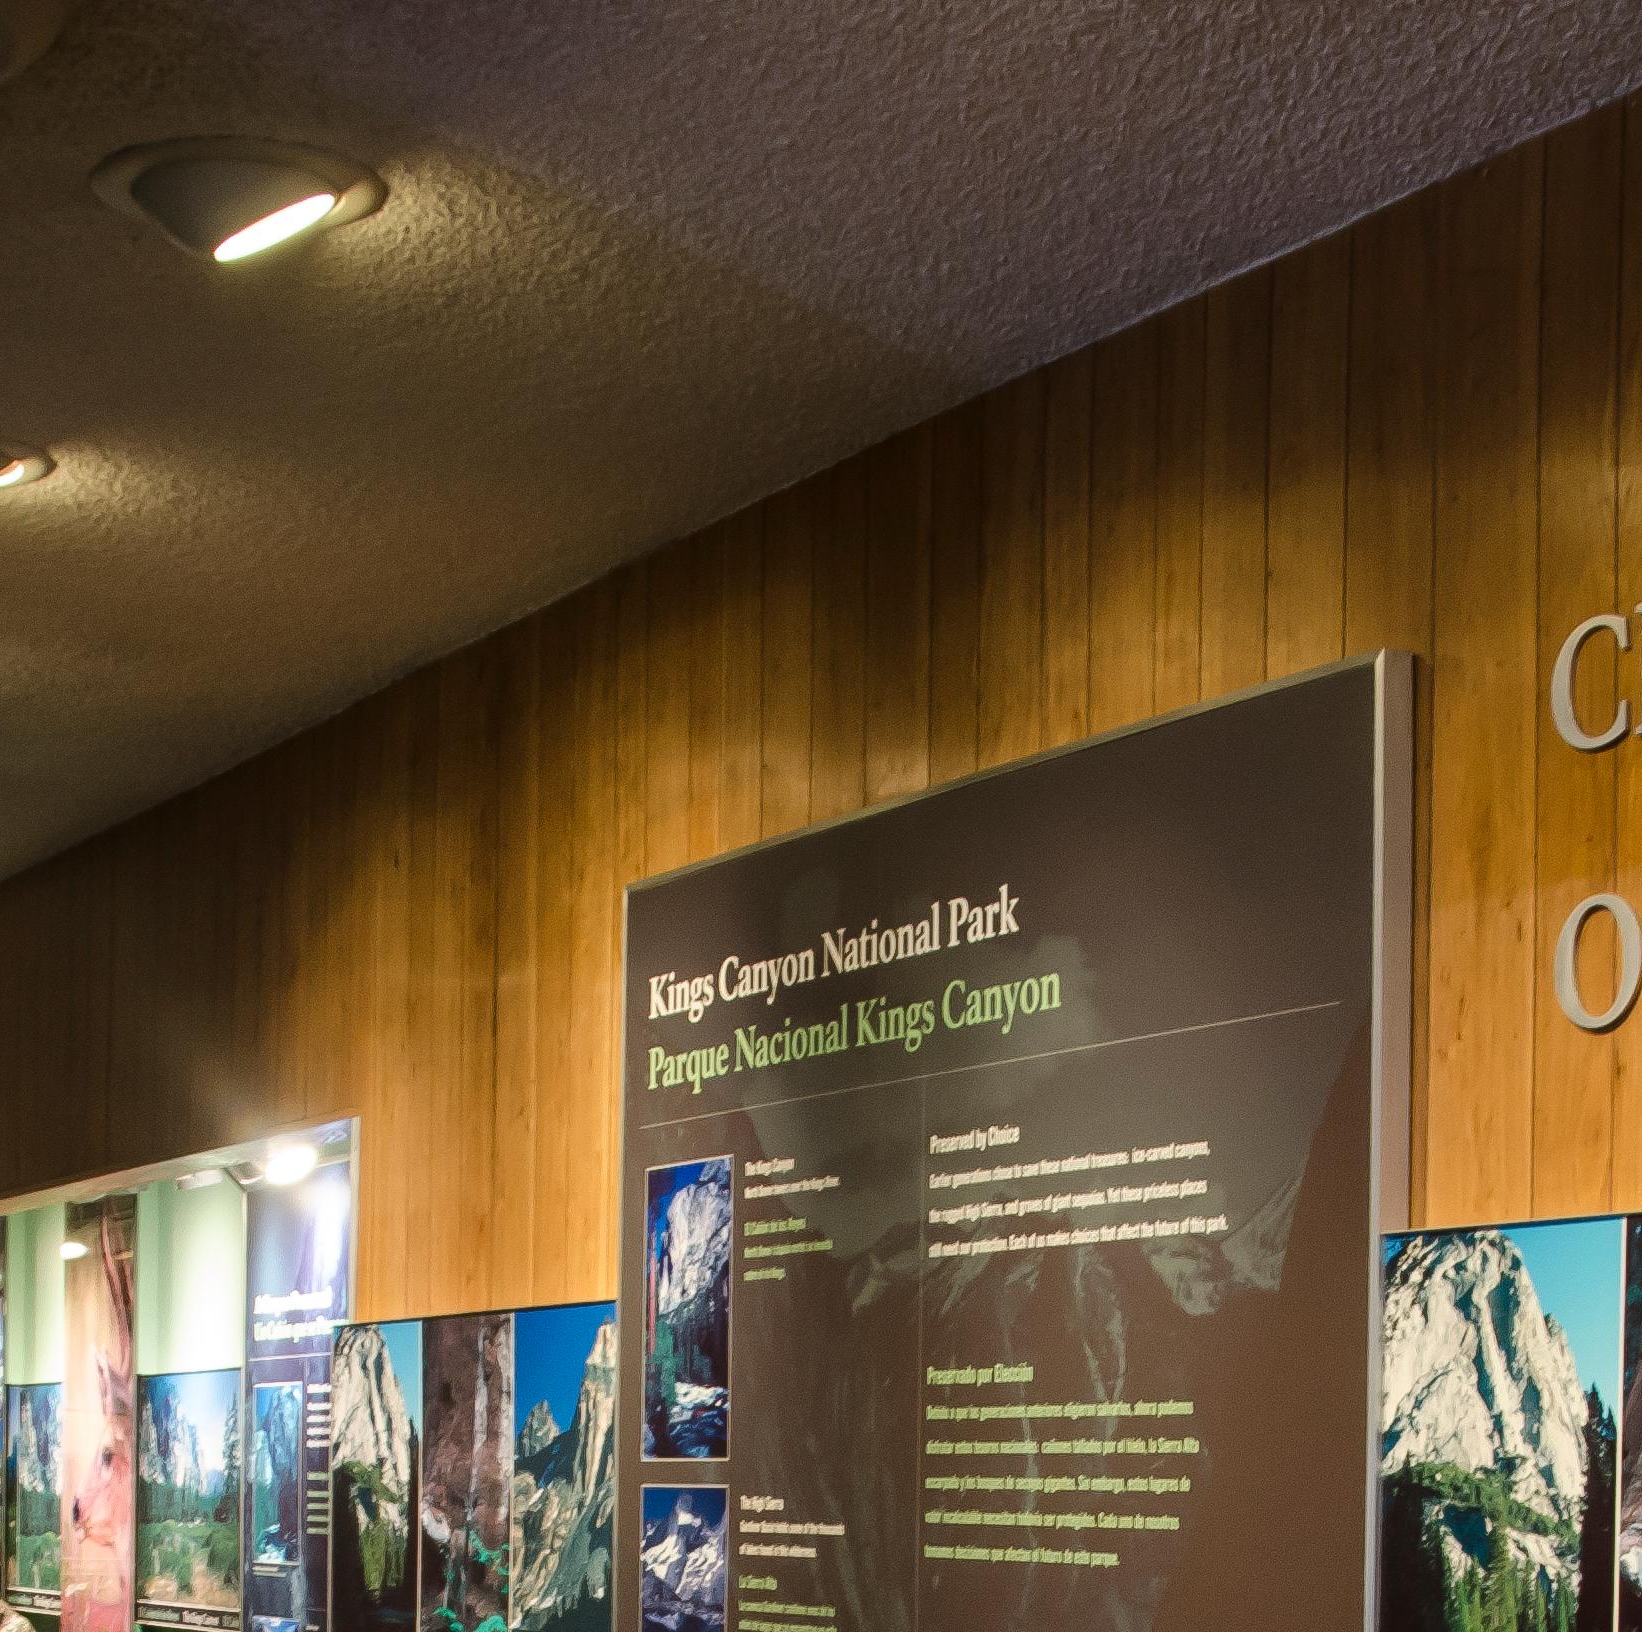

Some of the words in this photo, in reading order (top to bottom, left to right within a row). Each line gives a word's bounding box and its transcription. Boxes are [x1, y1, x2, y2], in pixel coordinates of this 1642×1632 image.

[648, 971, 714, 1022] Kings
[718, 949, 815, 1004] Canyon
[821, 901, 940, 977] National
[948, 884, 1019, 949] Park
[648, 1039, 729, 1093] Parque
[734, 1001, 848, 1070] Nacional
[856, 990, 934, 1052] Kings
[943, 970, 1060, 1035] Canyon
[975, 1128, 987, 1151] by
[987, 1124, 1020, 1146] Choice
